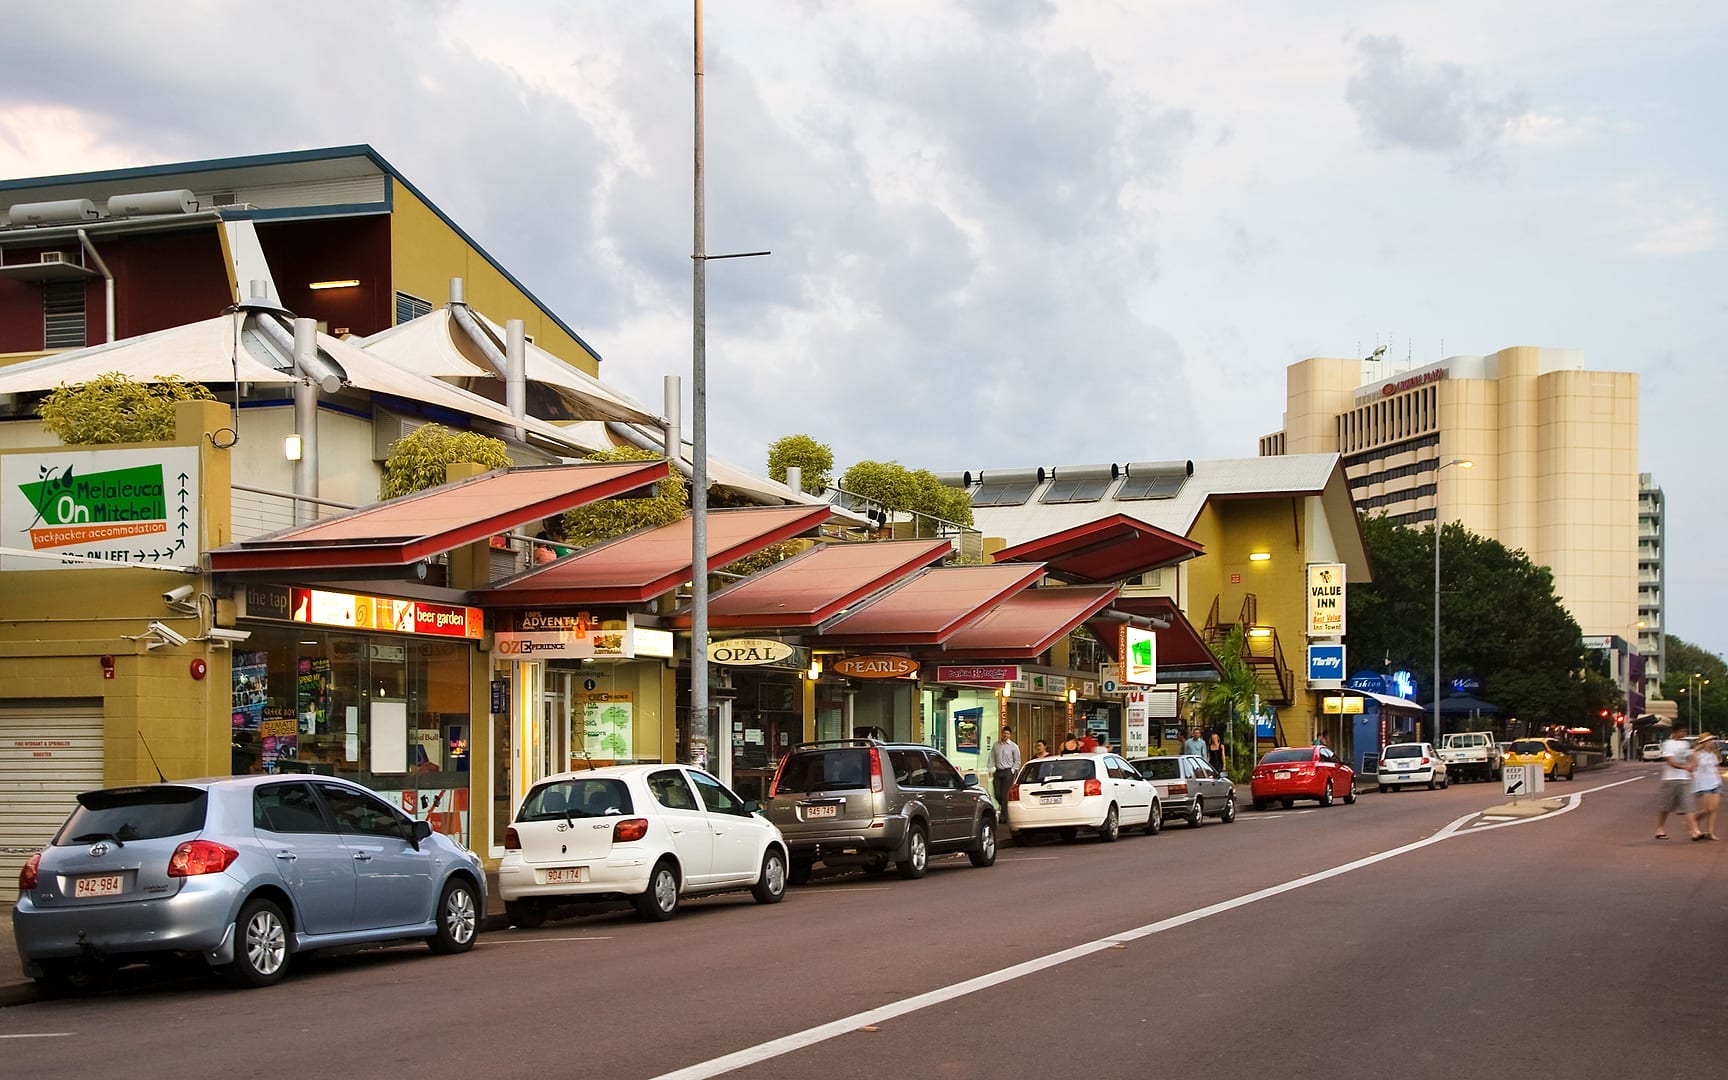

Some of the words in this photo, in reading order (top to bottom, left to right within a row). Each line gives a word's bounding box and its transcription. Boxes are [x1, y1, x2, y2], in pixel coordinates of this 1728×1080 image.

[77, 480, 163, 500] Melaleuca
[57, 495, 90, 523] On
[94, 501, 163, 521] Mitchell
[34, 529, 86, 545] backpacker
[88, 522, 165, 538] accommodation
[1312, 586, 1342, 596] VALUE
[248, 589, 266, 606] the
[270, 592, 288, 614] tap
[1317, 598, 1336, 608] INN
[416, 607, 435, 623] beer
[436, 610, 464, 628] garden
[522, 611, 599, 627] ADVENTURE
[499, 641, 520, 654] OZ
[713, 647, 777, 661] OPAL
[844, 660, 909, 673] PEARLS
[1312, 657, 1341, 669] Thrifty
[425, 733, 439, 741] Bull
